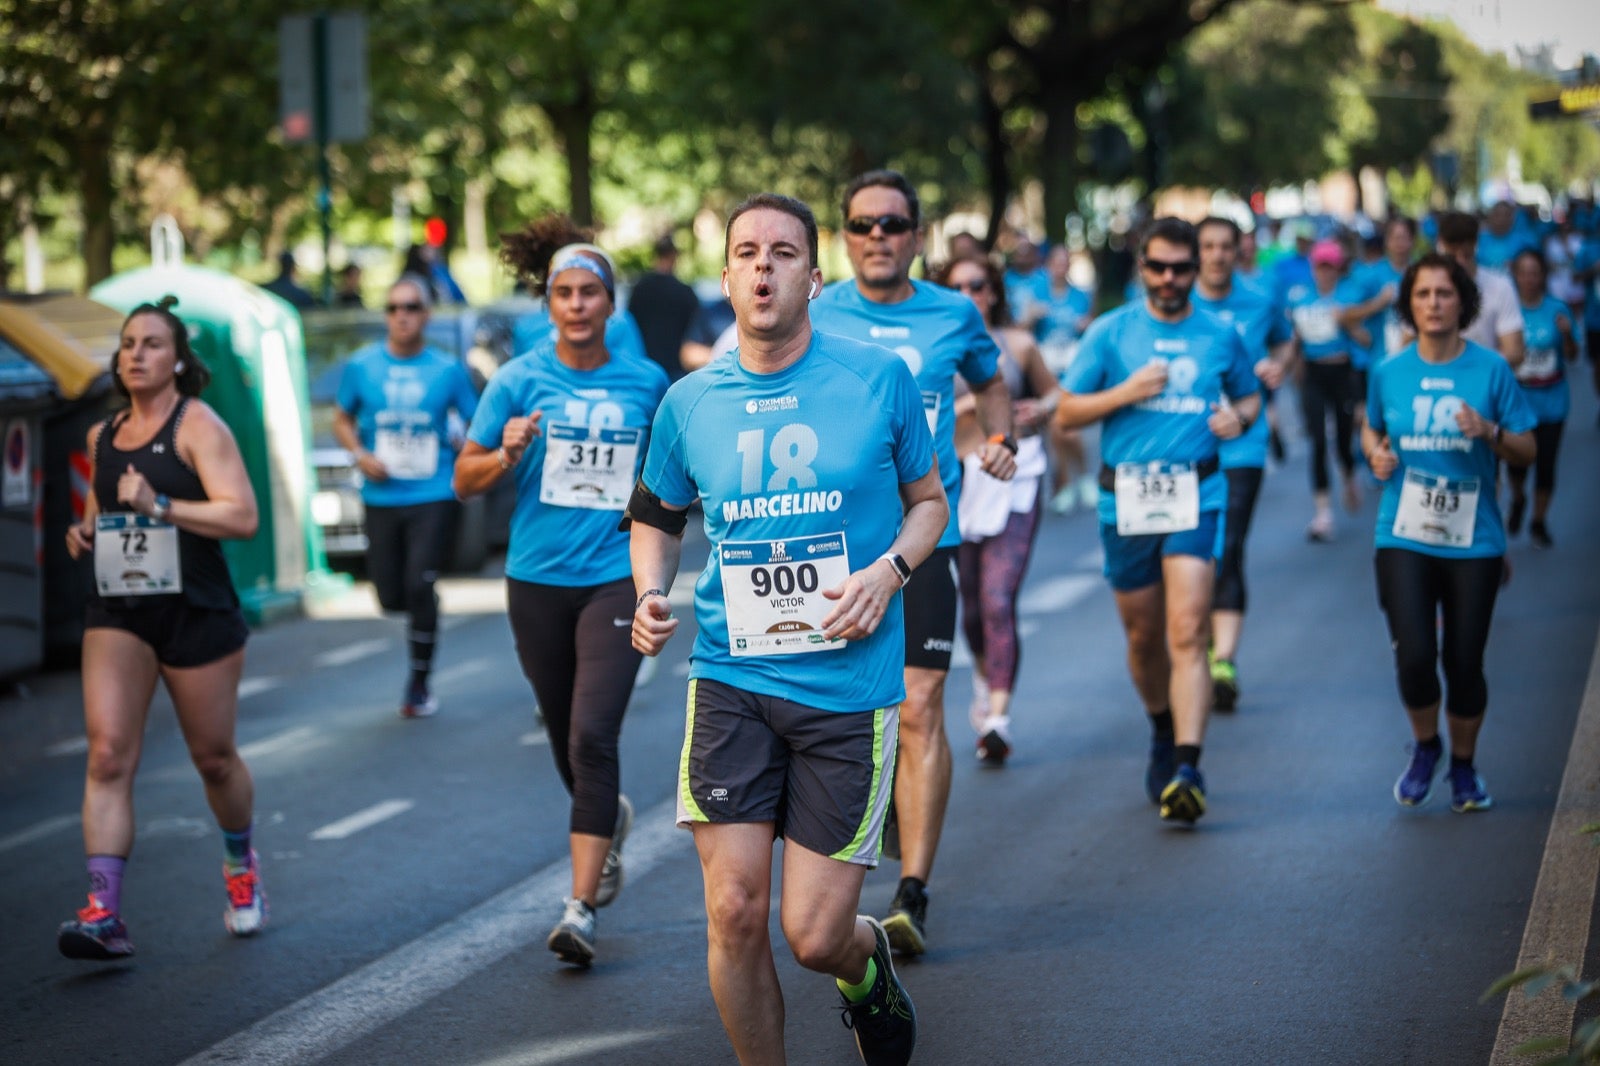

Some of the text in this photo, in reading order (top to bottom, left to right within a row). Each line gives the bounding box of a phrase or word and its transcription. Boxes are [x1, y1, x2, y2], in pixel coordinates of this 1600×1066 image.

[758, 396, 798, 407] OXIMESA
[1411, 395, 1463, 434] 18
[569, 444, 614, 468] 311
[736, 423, 819, 496] 18
[722, 490, 843, 522] MARCELINO
[119, 532, 148, 555] 72
[770, 542, 786, 554] 18
[750, 562, 819, 598] 900
[770, 597, 805, 609] VICTOR
